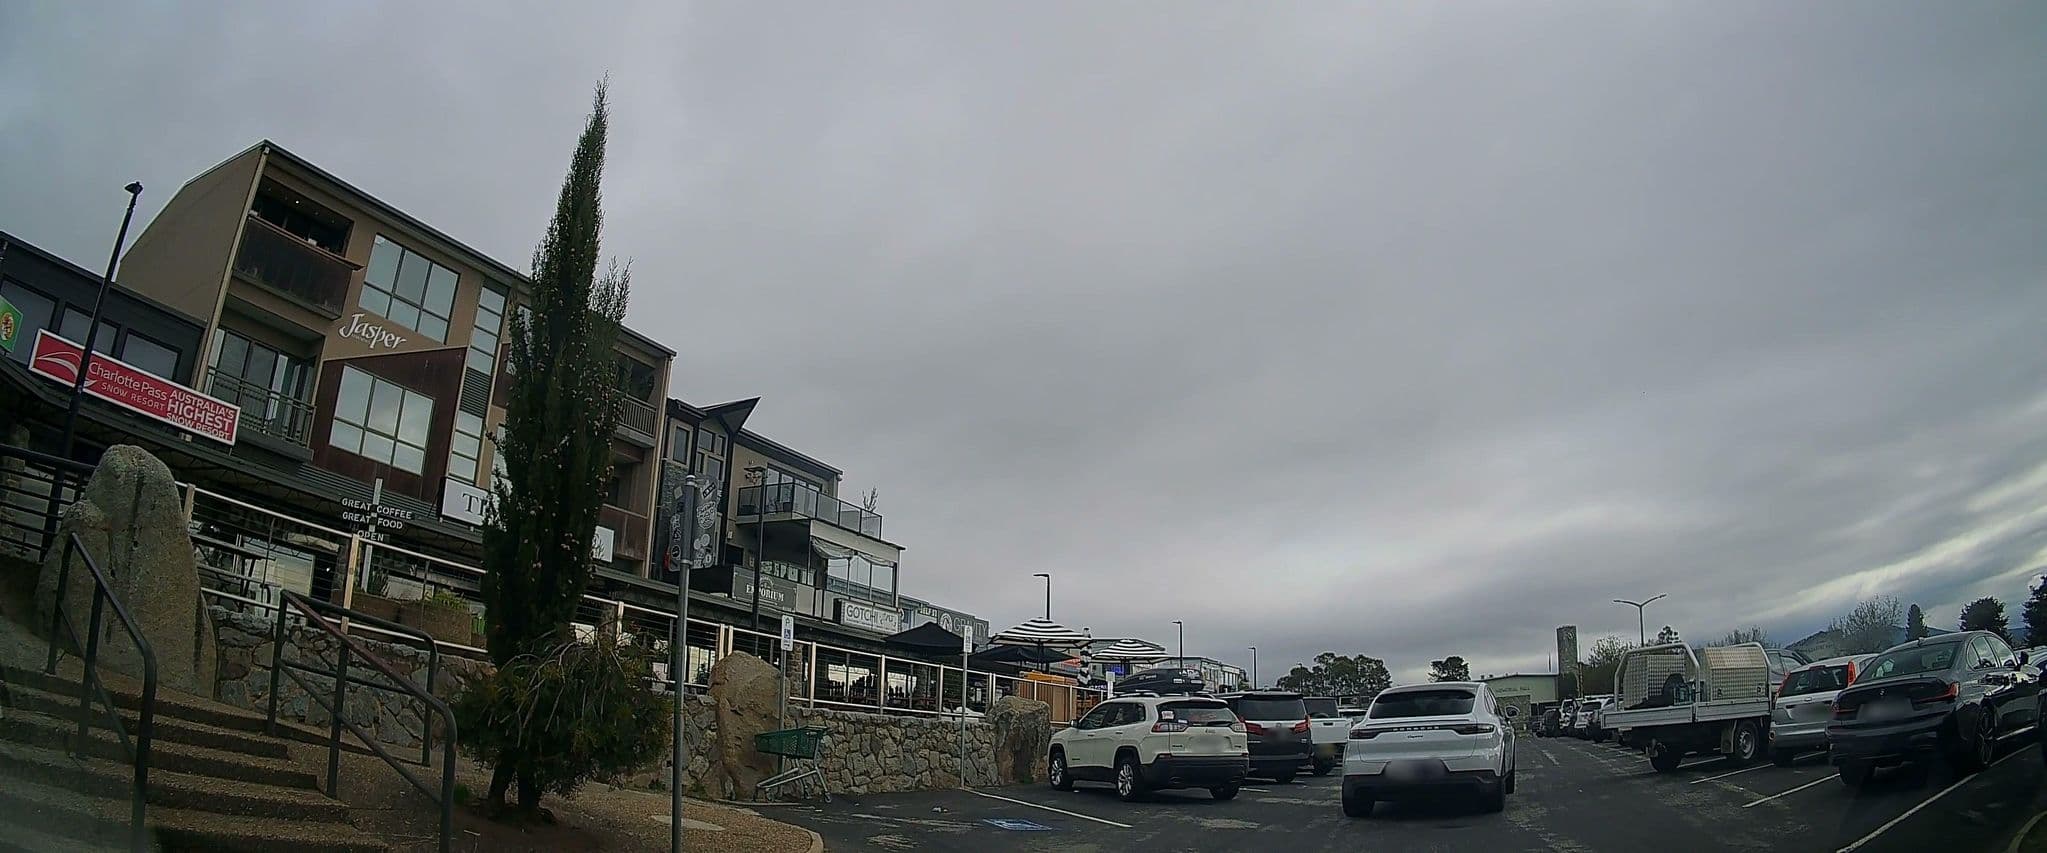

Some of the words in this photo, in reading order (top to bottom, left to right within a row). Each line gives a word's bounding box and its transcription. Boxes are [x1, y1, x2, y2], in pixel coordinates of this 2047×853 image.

[338, 313, 407, 349] Jasper
[88, 361, 141, 391] Charlotte
[141, 381, 168, 401] Pass
[101, 382, 128, 397] SNOW
[130, 393, 166, 410] RESORT
[170, 390, 235, 420] AUSTRALIA'S
[166, 412, 195, 429] SNOW
[195, 422, 231, 440] RESORT
[167, 398, 233, 431] HIGHEST
[341, 497, 371, 511] GREAT
[376, 504, 412, 520] COFFEE
[342, 511, 371, 524] GREAT
[377, 517, 403, 530] FOOD
[357, 529, 384, 542] OPEN
